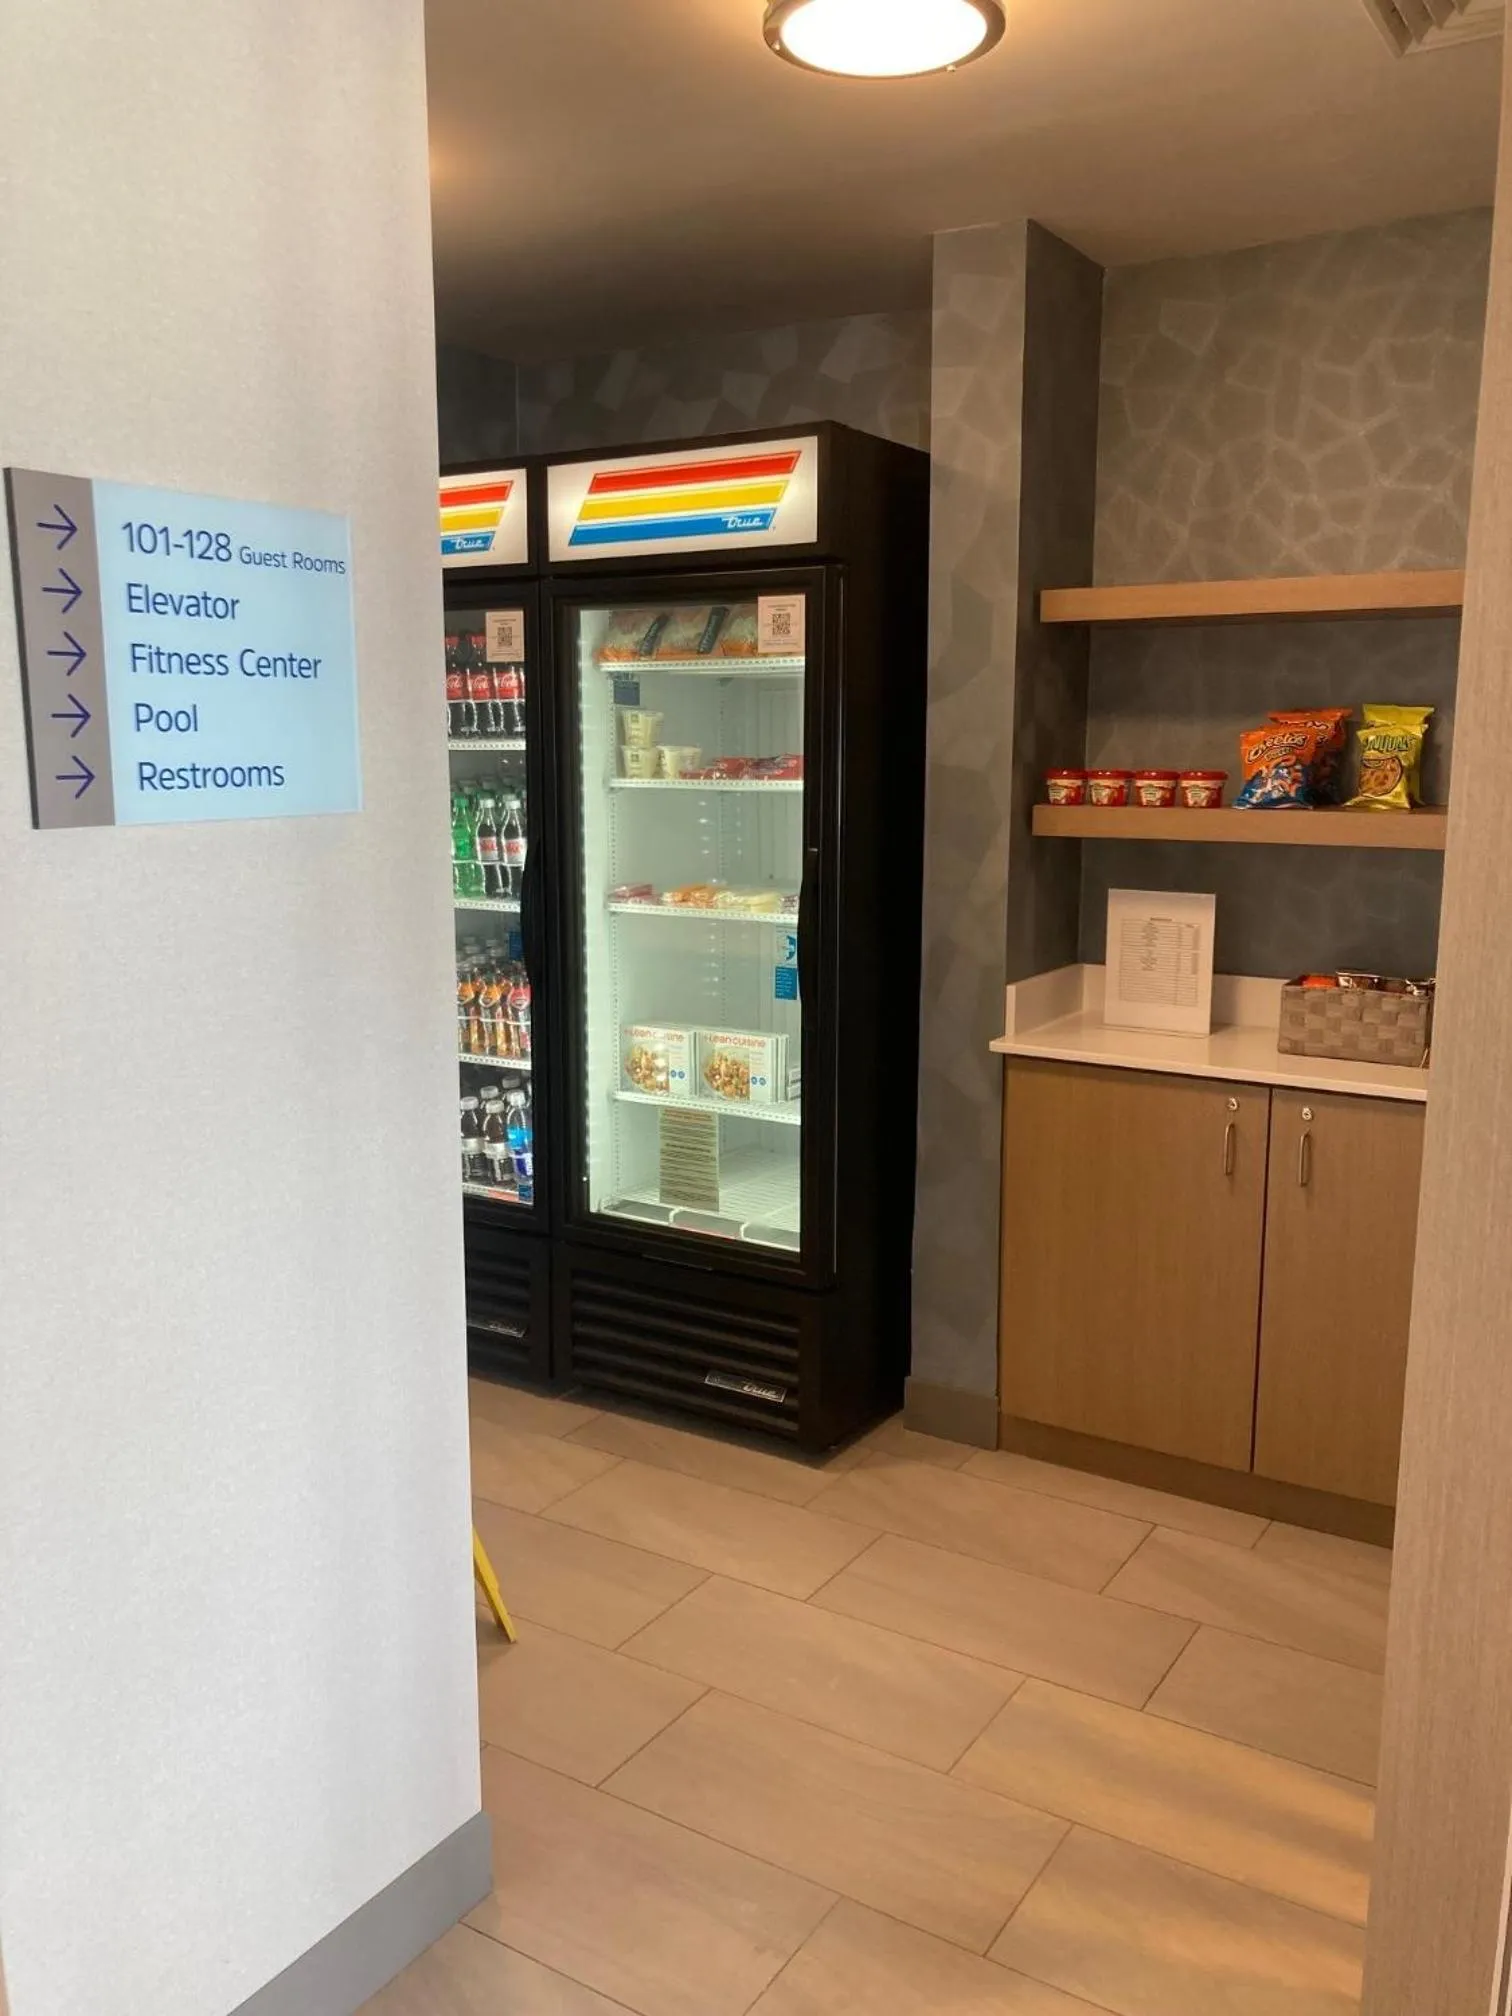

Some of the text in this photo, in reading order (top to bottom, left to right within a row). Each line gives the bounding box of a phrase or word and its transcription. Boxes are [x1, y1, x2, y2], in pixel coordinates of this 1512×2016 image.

[121, 521, 347, 575] 101-128 Guest Rooms
[125, 582, 241, 621] Elevator
[129, 643, 323, 680] Fitness Center
[134, 702, 199, 734] Pool
[137, 761, 286, 792] Restrooms
